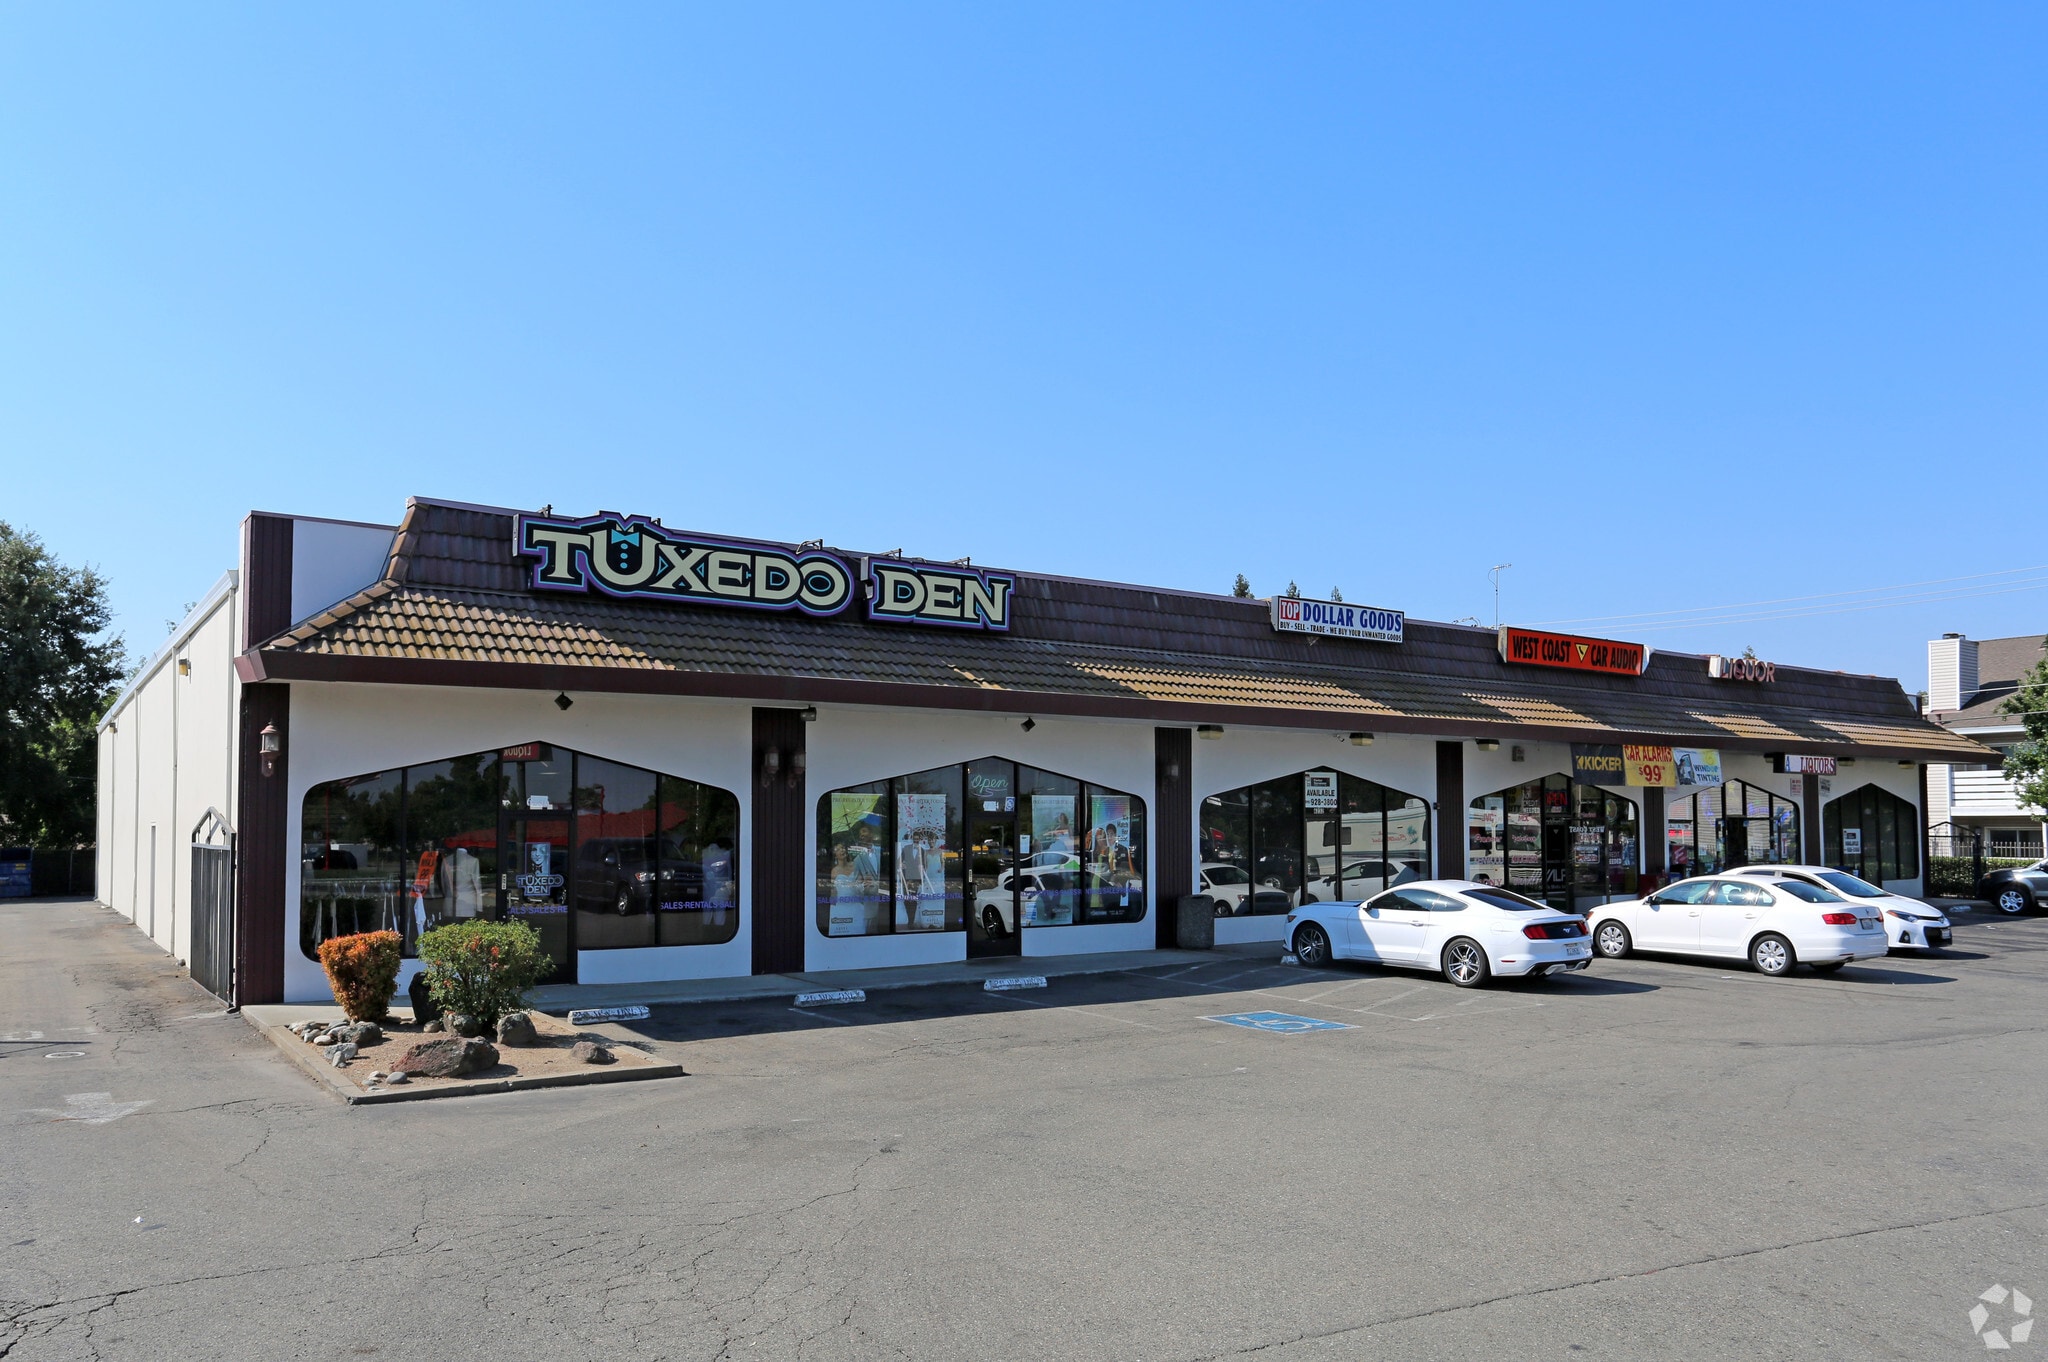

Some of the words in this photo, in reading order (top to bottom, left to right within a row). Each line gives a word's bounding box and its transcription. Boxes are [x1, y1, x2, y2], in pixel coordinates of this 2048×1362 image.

[532, 528, 850, 606] TUXEDO
[873, 569, 1008, 622] DEN
[1281, 602, 1299, 619] TOP
[1303, 602, 1354, 627] DOLLAR
[1360, 609, 1401, 632] GOODS
[1280, 621, 1290, 629] BUY
[1310, 625, 1325, 633] TRADE
[1330, 626, 1337, 635] WE
[1338, 628, 1348, 636] BUY
[1349, 629, 1361, 637] YOUR
[1362, 631, 1386, 640] UNWANTED
[1387, 633, 1402, 642] GOODS
[1512, 635, 1539, 660] WEST
[1542, 638, 1571, 662] COAST
[1590, 644, 1608, 667] CAR
[1610, 645, 1638, 670] AUDIO
[1720, 657, 1775, 682] LIQUOR
[1623, 745, 1641, 761] CAR
[1643, 745, 1673, 762] ALARMS
[1584, 756, 1622, 771] KICKER
[1800, 757, 1835, 774] LIQUORS
[971, 775, 1008, 794] Open
[1307, 789, 1335, 797] AVAILABLE
[527, 886, 548, 894] DEN
